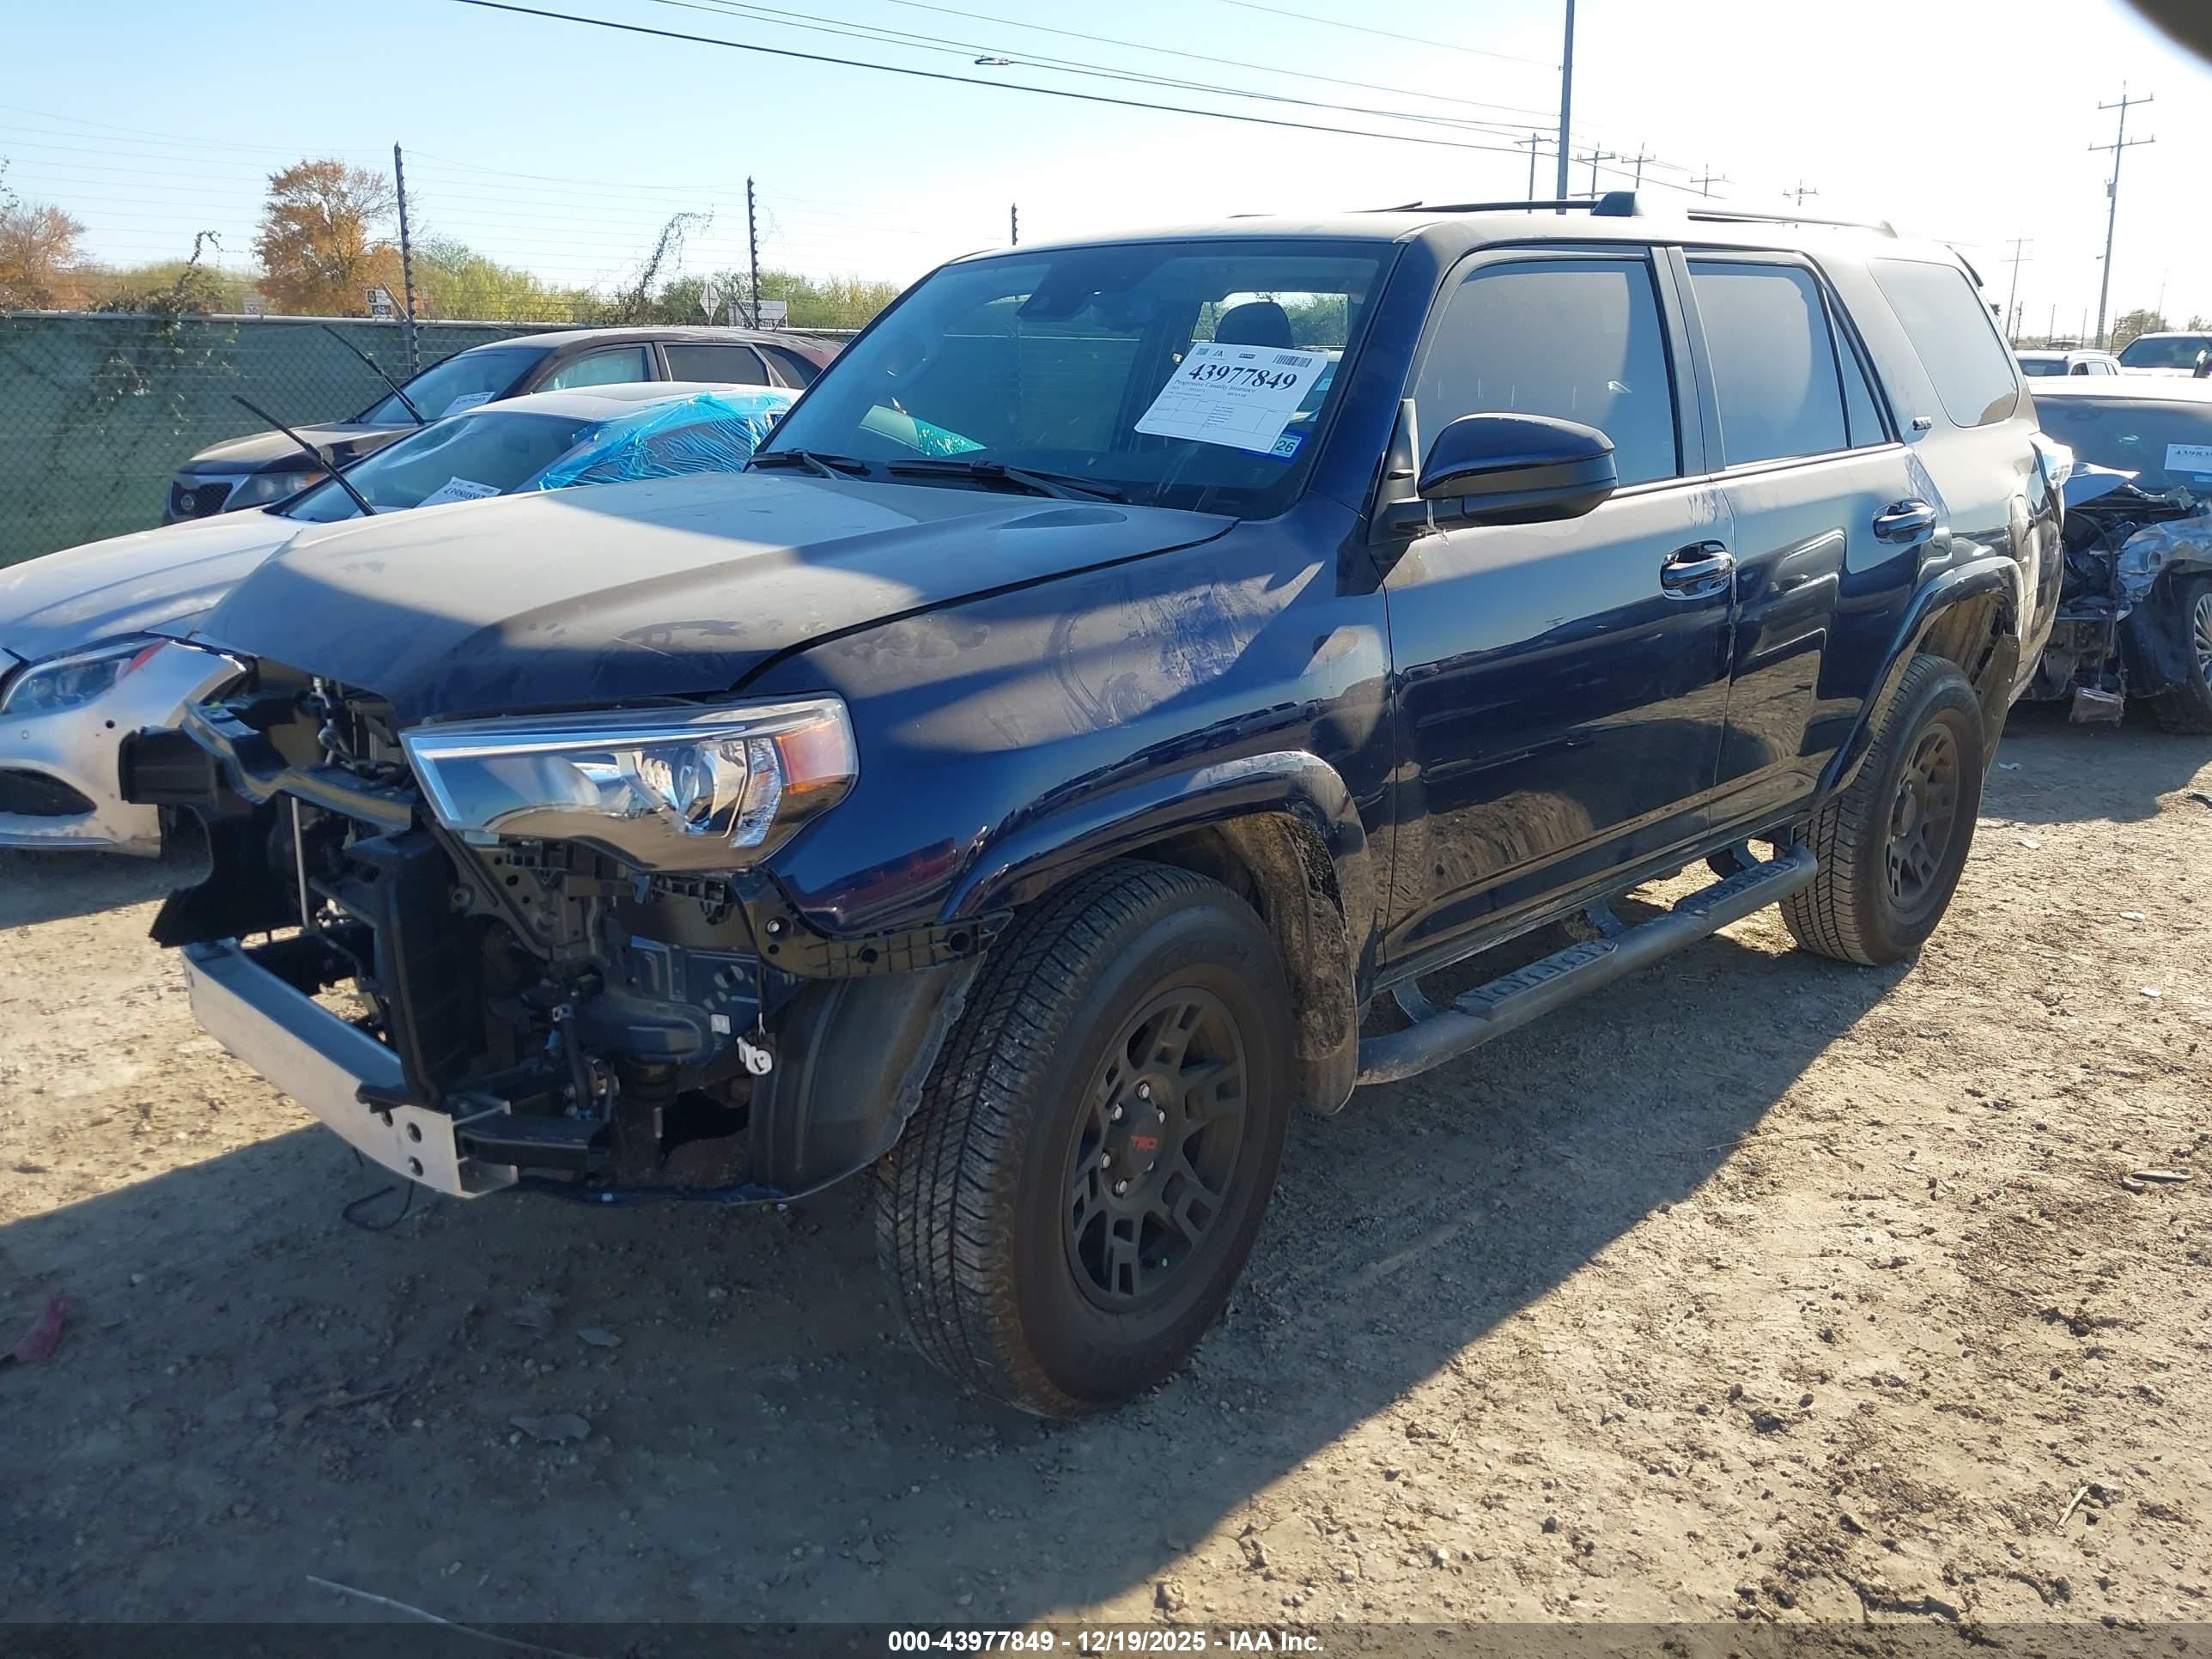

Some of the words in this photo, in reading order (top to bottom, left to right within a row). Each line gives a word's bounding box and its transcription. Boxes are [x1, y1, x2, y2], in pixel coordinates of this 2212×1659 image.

[1188, 363, 1297, 390] 43977849
[1275, 441, 1296, 453] 26
[1131, 1134, 1157, 1152] TRD
